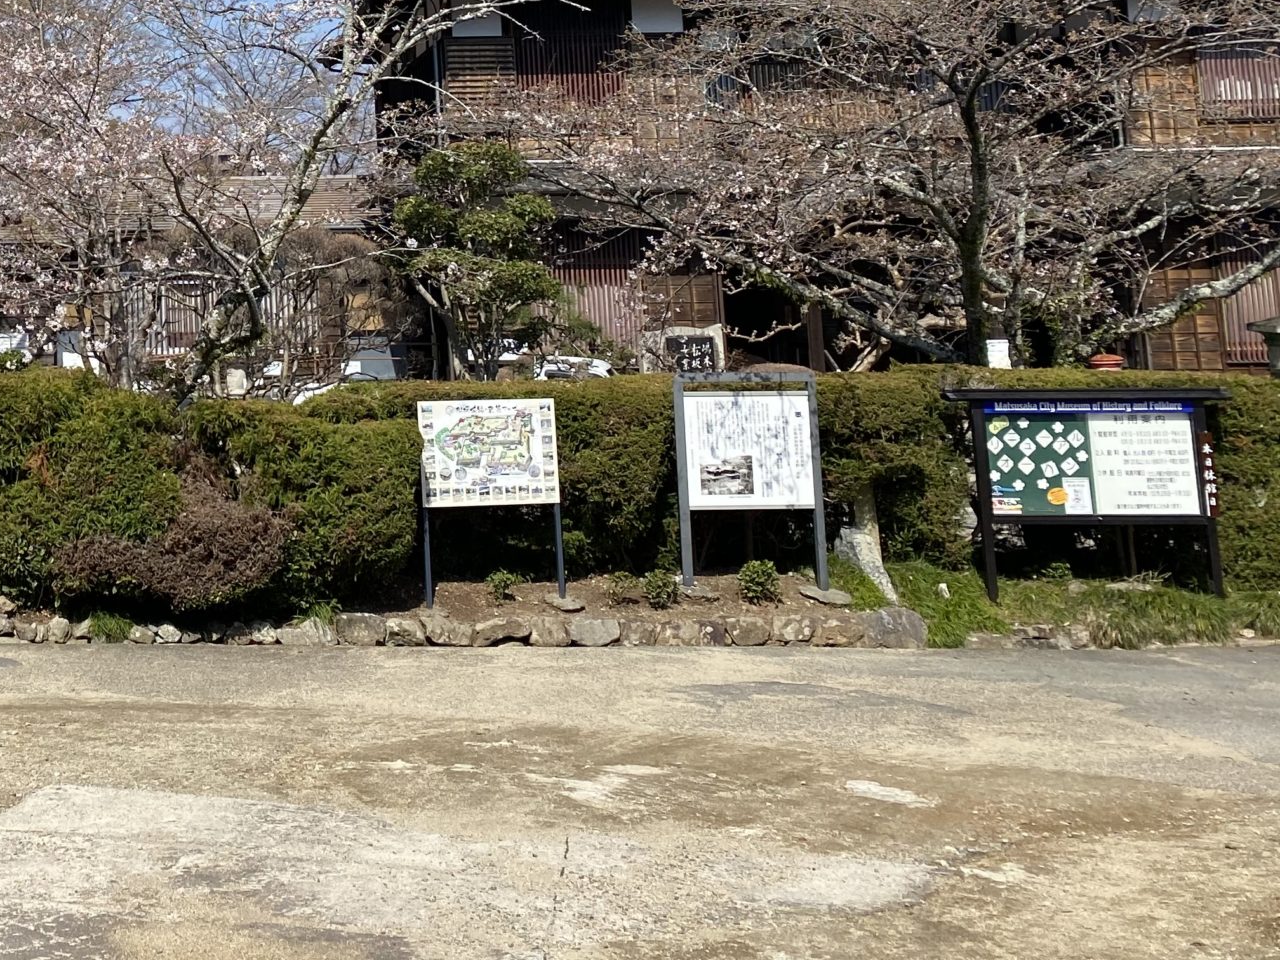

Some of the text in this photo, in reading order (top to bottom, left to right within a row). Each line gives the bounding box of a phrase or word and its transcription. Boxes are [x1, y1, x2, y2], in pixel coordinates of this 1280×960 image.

[994, 401, 1183, 413] Matsusaka City Museum of History and Folklore
